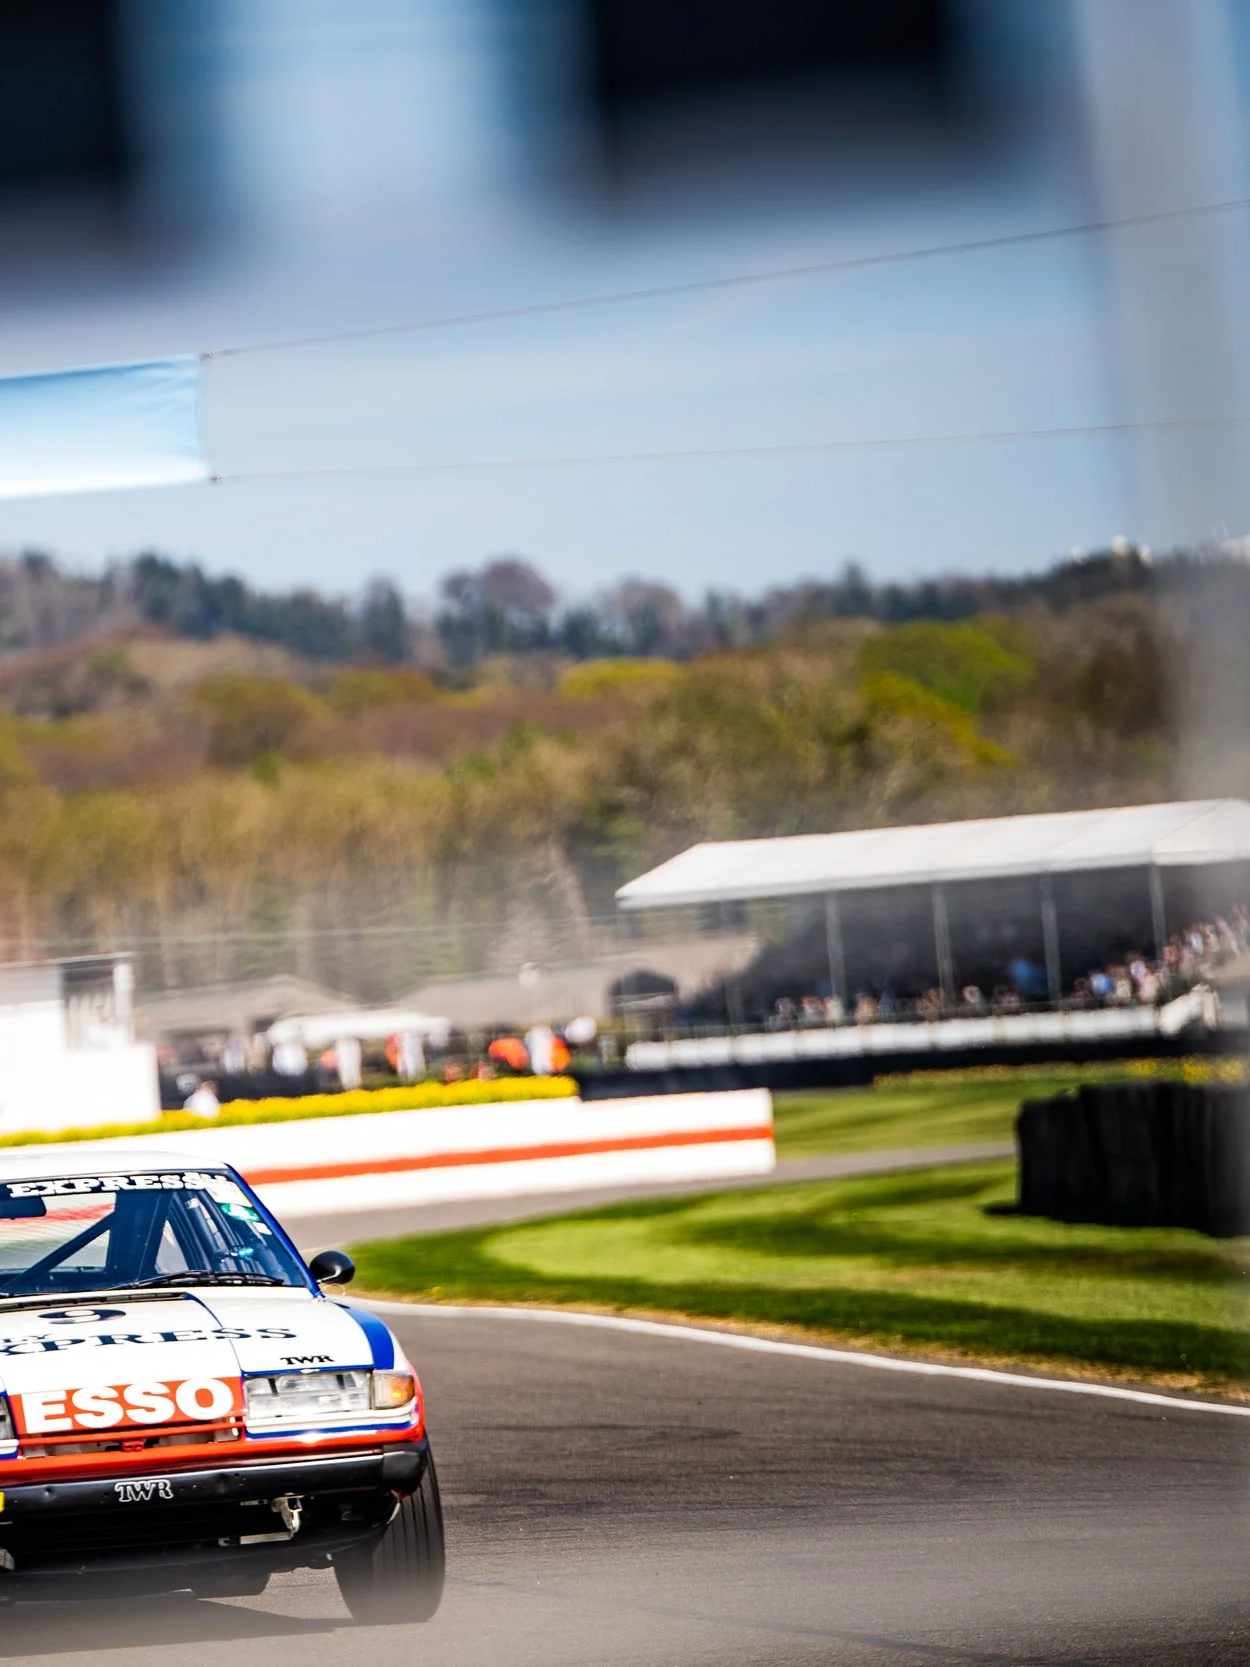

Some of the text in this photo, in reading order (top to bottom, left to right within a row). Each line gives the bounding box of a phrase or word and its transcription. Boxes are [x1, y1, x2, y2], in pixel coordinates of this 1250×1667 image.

[6, 1172, 208, 1199] EXPRESS
[38, 1308, 127, 1325] 9
[279, 1354, 335, 1365] TWR
[20, 1377, 234, 1434] ESSO
[114, 1478, 174, 1502] TWR
